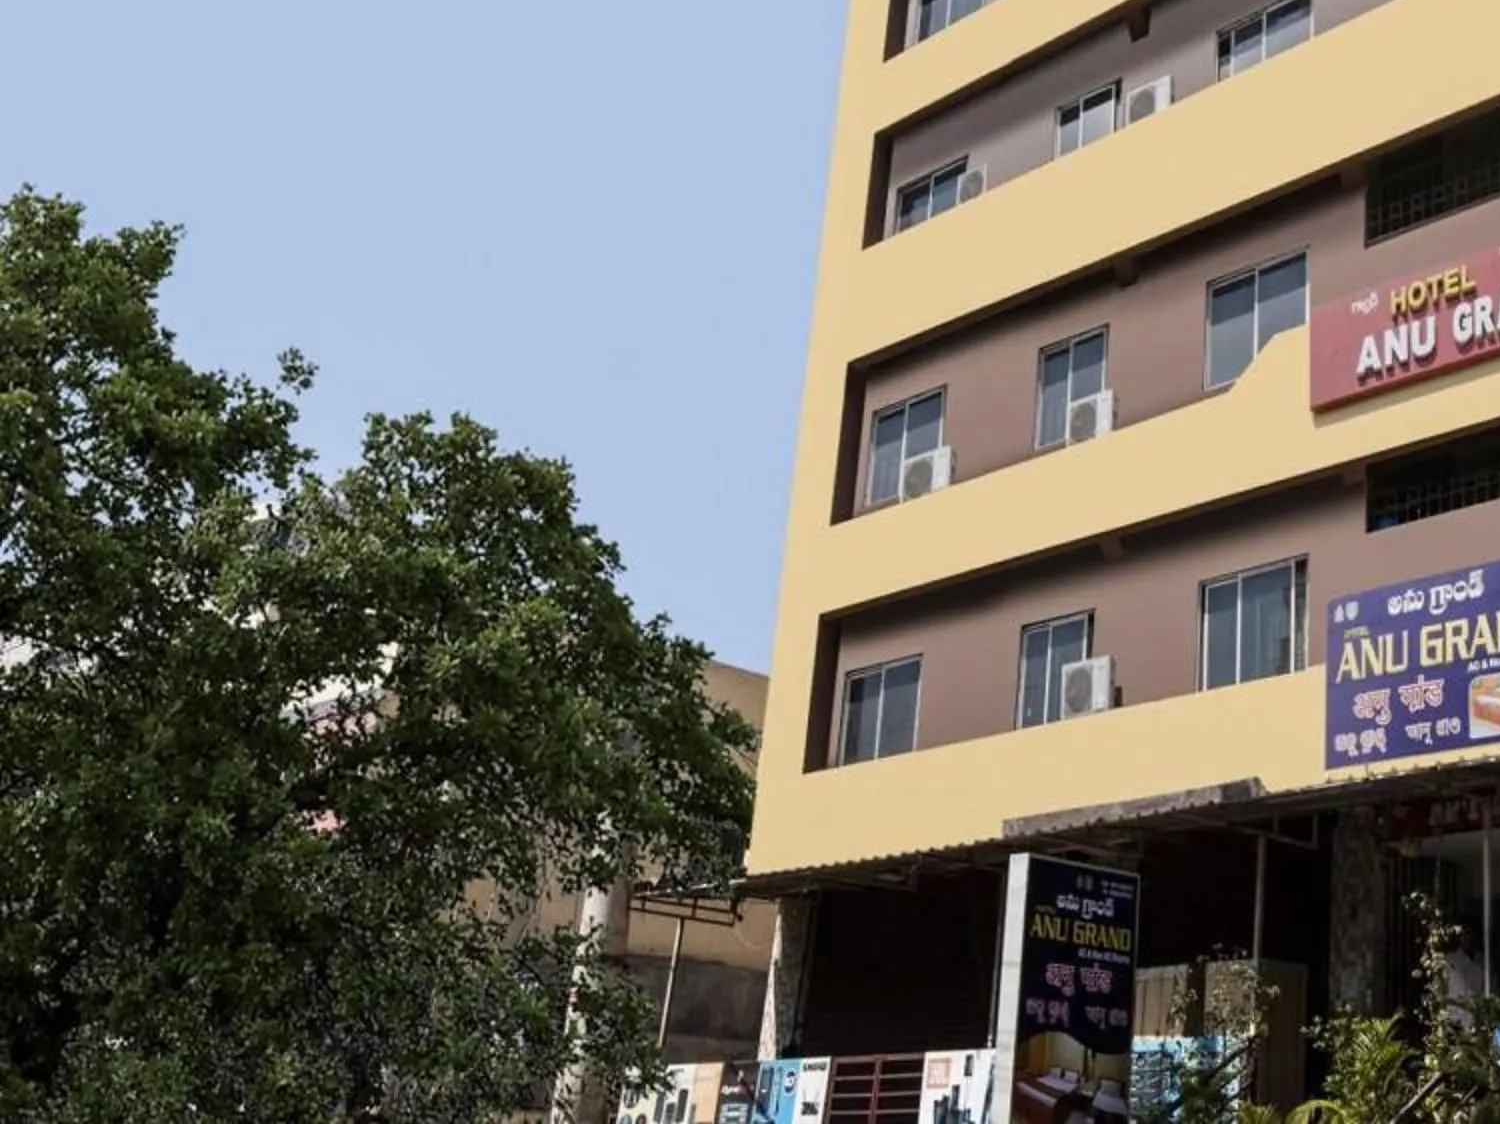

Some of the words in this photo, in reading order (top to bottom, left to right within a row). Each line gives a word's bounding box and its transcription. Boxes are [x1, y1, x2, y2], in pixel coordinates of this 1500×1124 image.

[1390, 265, 1476, 314] HOTEL
[1357, 316, 1436, 374] ANU
[1336, 629, 1409, 684] ANU
[1030, 912, 1069, 941] ANU
[1073, 920, 1132, 951] GRAND
